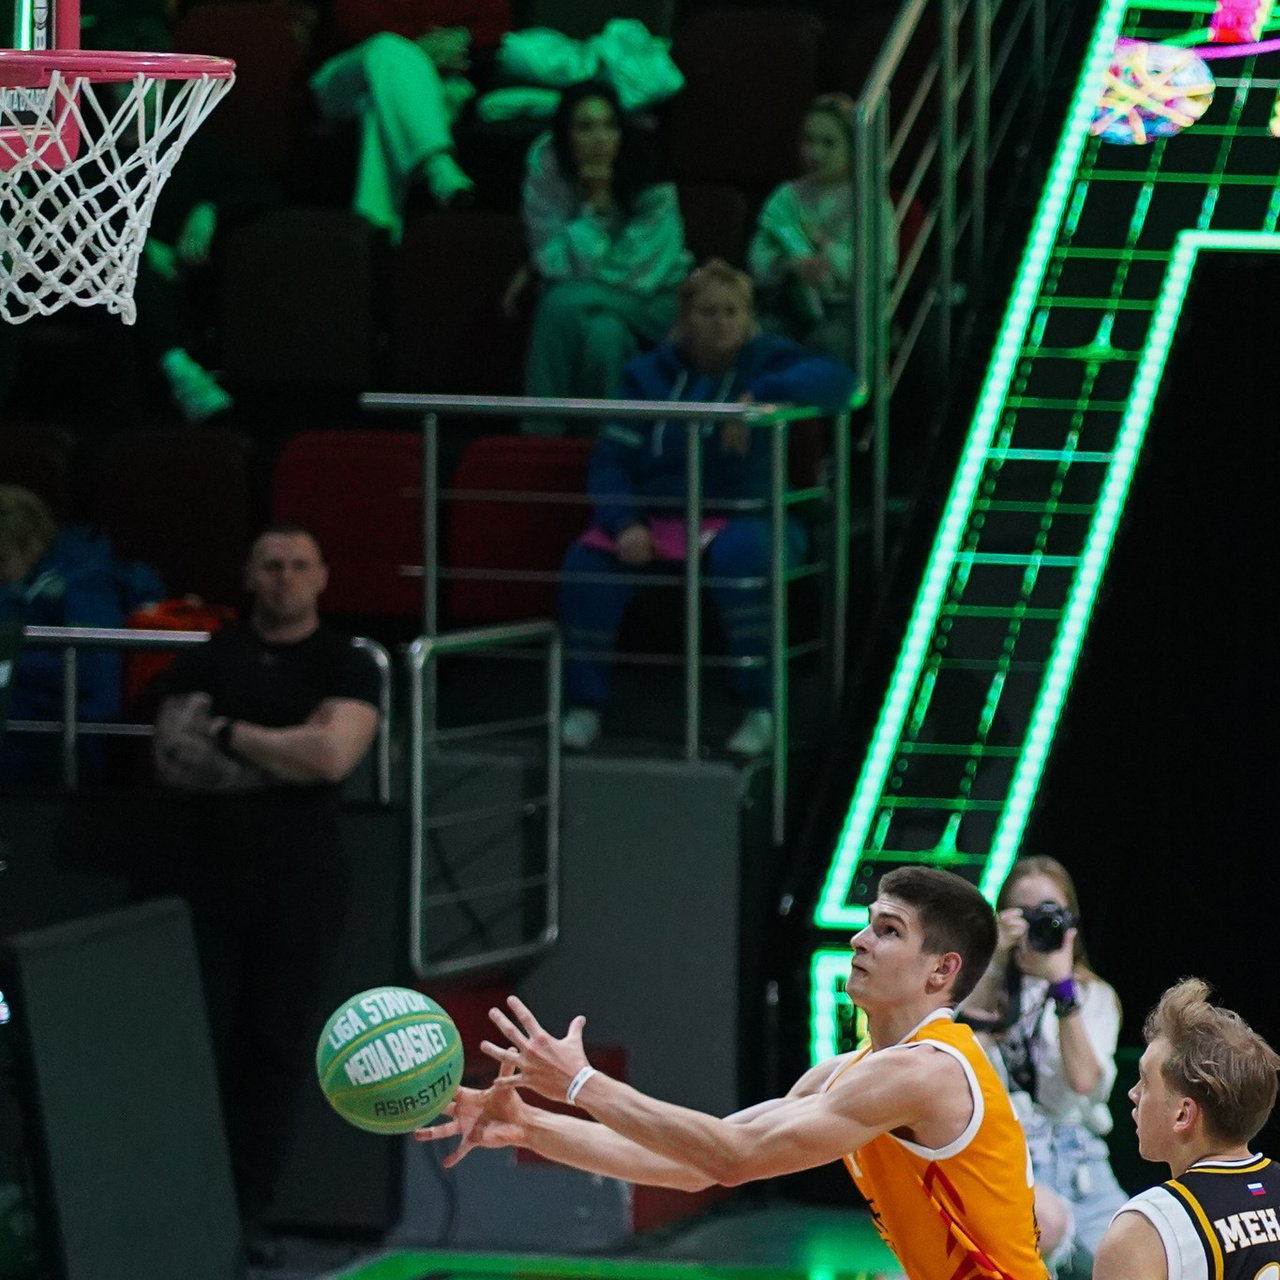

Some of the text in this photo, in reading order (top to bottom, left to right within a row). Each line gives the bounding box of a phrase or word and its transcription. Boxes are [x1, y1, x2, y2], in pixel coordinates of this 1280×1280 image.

[328, 991, 430, 1050] LIGA STAVOK
[344, 1022, 448, 1086] MEDIA BASKET
